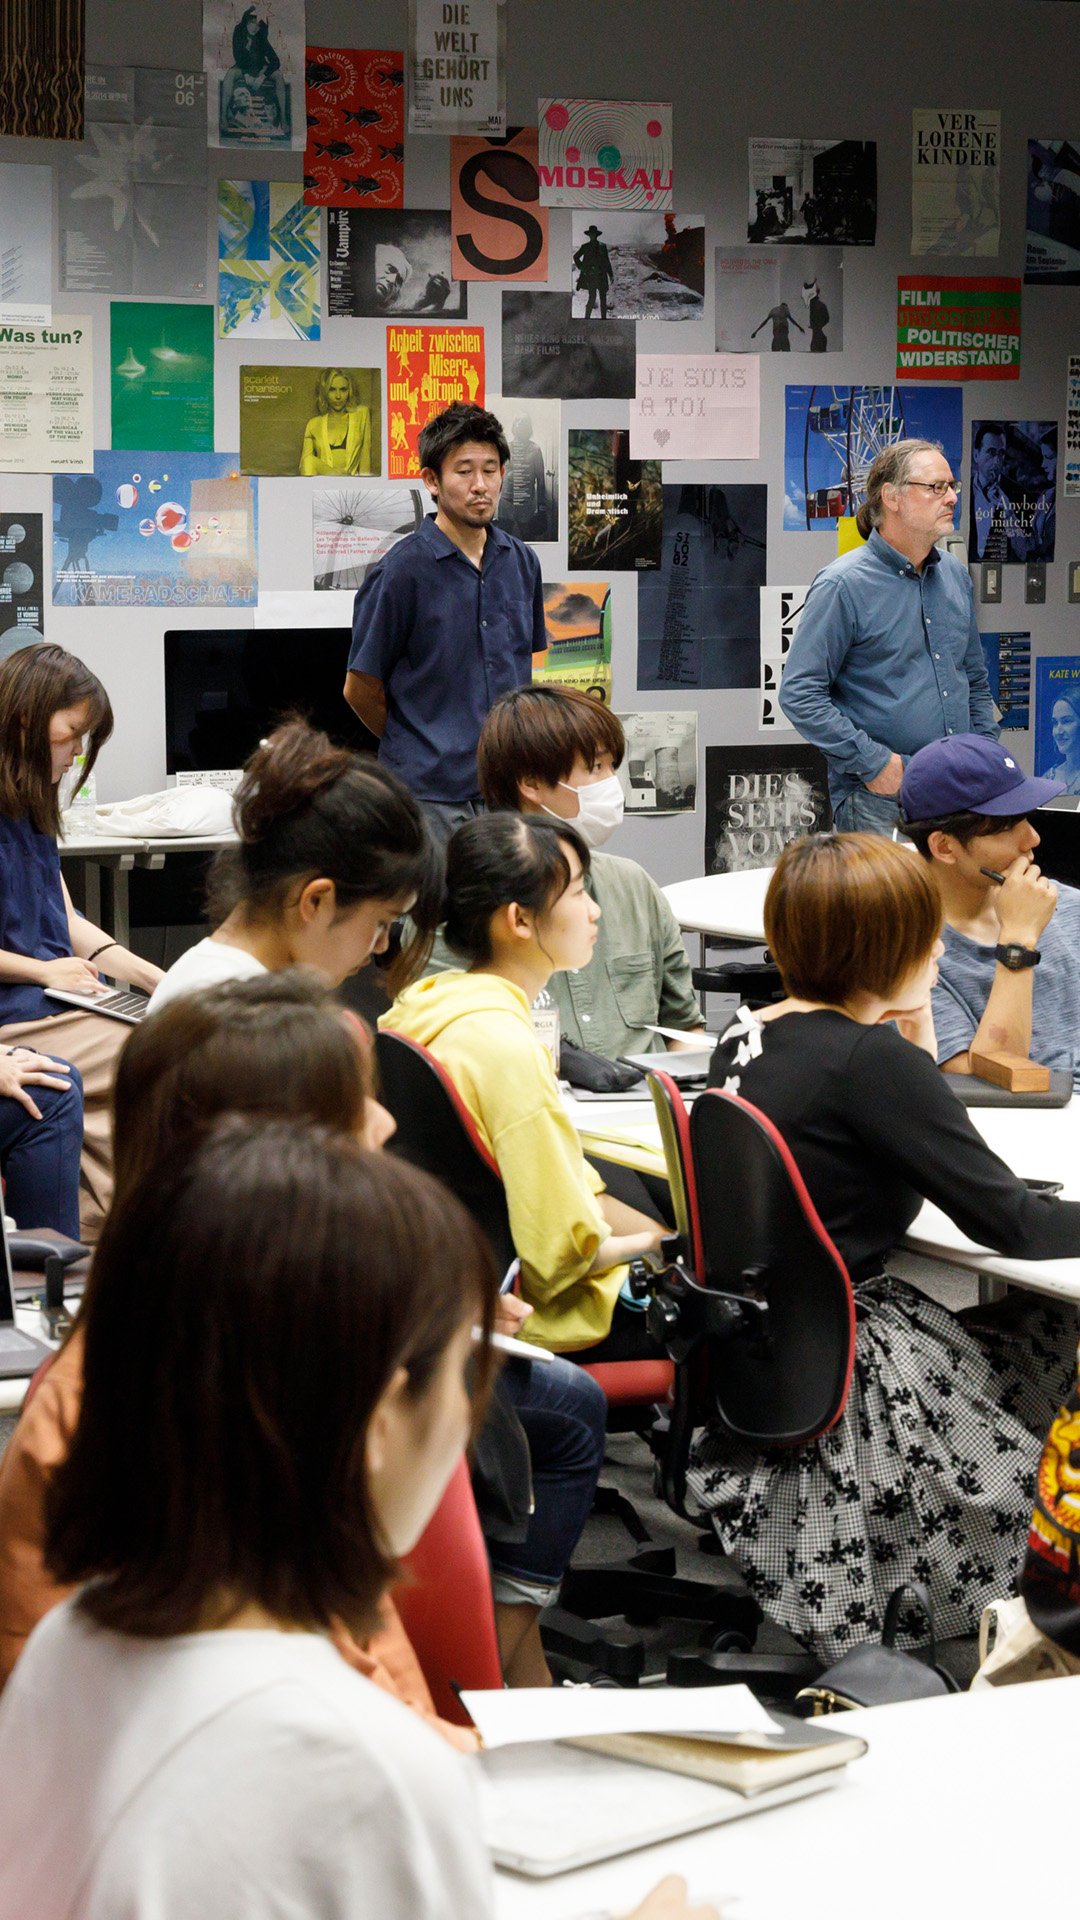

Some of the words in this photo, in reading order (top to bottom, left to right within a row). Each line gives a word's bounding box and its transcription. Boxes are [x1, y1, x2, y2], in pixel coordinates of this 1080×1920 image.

[443, 4, 470, 25] DIE
[434, 31, 479, 54] WELT
[422, 55, 490, 81] GEHÖRT
[175, 91, 195, 106] 06
[440, 86, 474, 108] UNS
[488, 115, 502, 125] MAI
[916, 130, 997, 149] LORENE
[916, 148, 997, 166] KINDER
[539, 166, 673, 190] MOSKAU
[336, 210, 352, 258] Vampire
[900, 290, 941, 306] FILM
[0, 328, 36, 343] Was
[41, 329, 83, 345] tun?
[389, 328, 424, 352] Arbeit
[429, 329, 481, 353] zwischen
[907, 328, 1020, 350] POLITISCHER
[536, 345, 561, 355] FILMS
[899, 350, 1013, 367] WIDERSTAND
[428, 353, 469, 377] Misere
[243, 376, 279, 384] scarlett
[639, 367, 674, 388] JE
[684, 367, 746, 388] SUIS
[243, 385, 293, 395] johansson
[389, 378, 410, 401] und
[430, 378, 464, 405] Utopie
[665, 396, 706, 417] TOI
[391, 450, 404, 475] im
[975, 507, 995, 521] got
[999, 510, 1007, 519] a
[995, 494, 1052, 514] Anybody
[991, 511, 1035, 528] match?
[70, 585, 254, 604] KAMERADSCHAFT
[1049, 669, 1070, 679] KATE
[728, 772, 801, 800] DIES
[728, 801, 816, 829] SEITS
